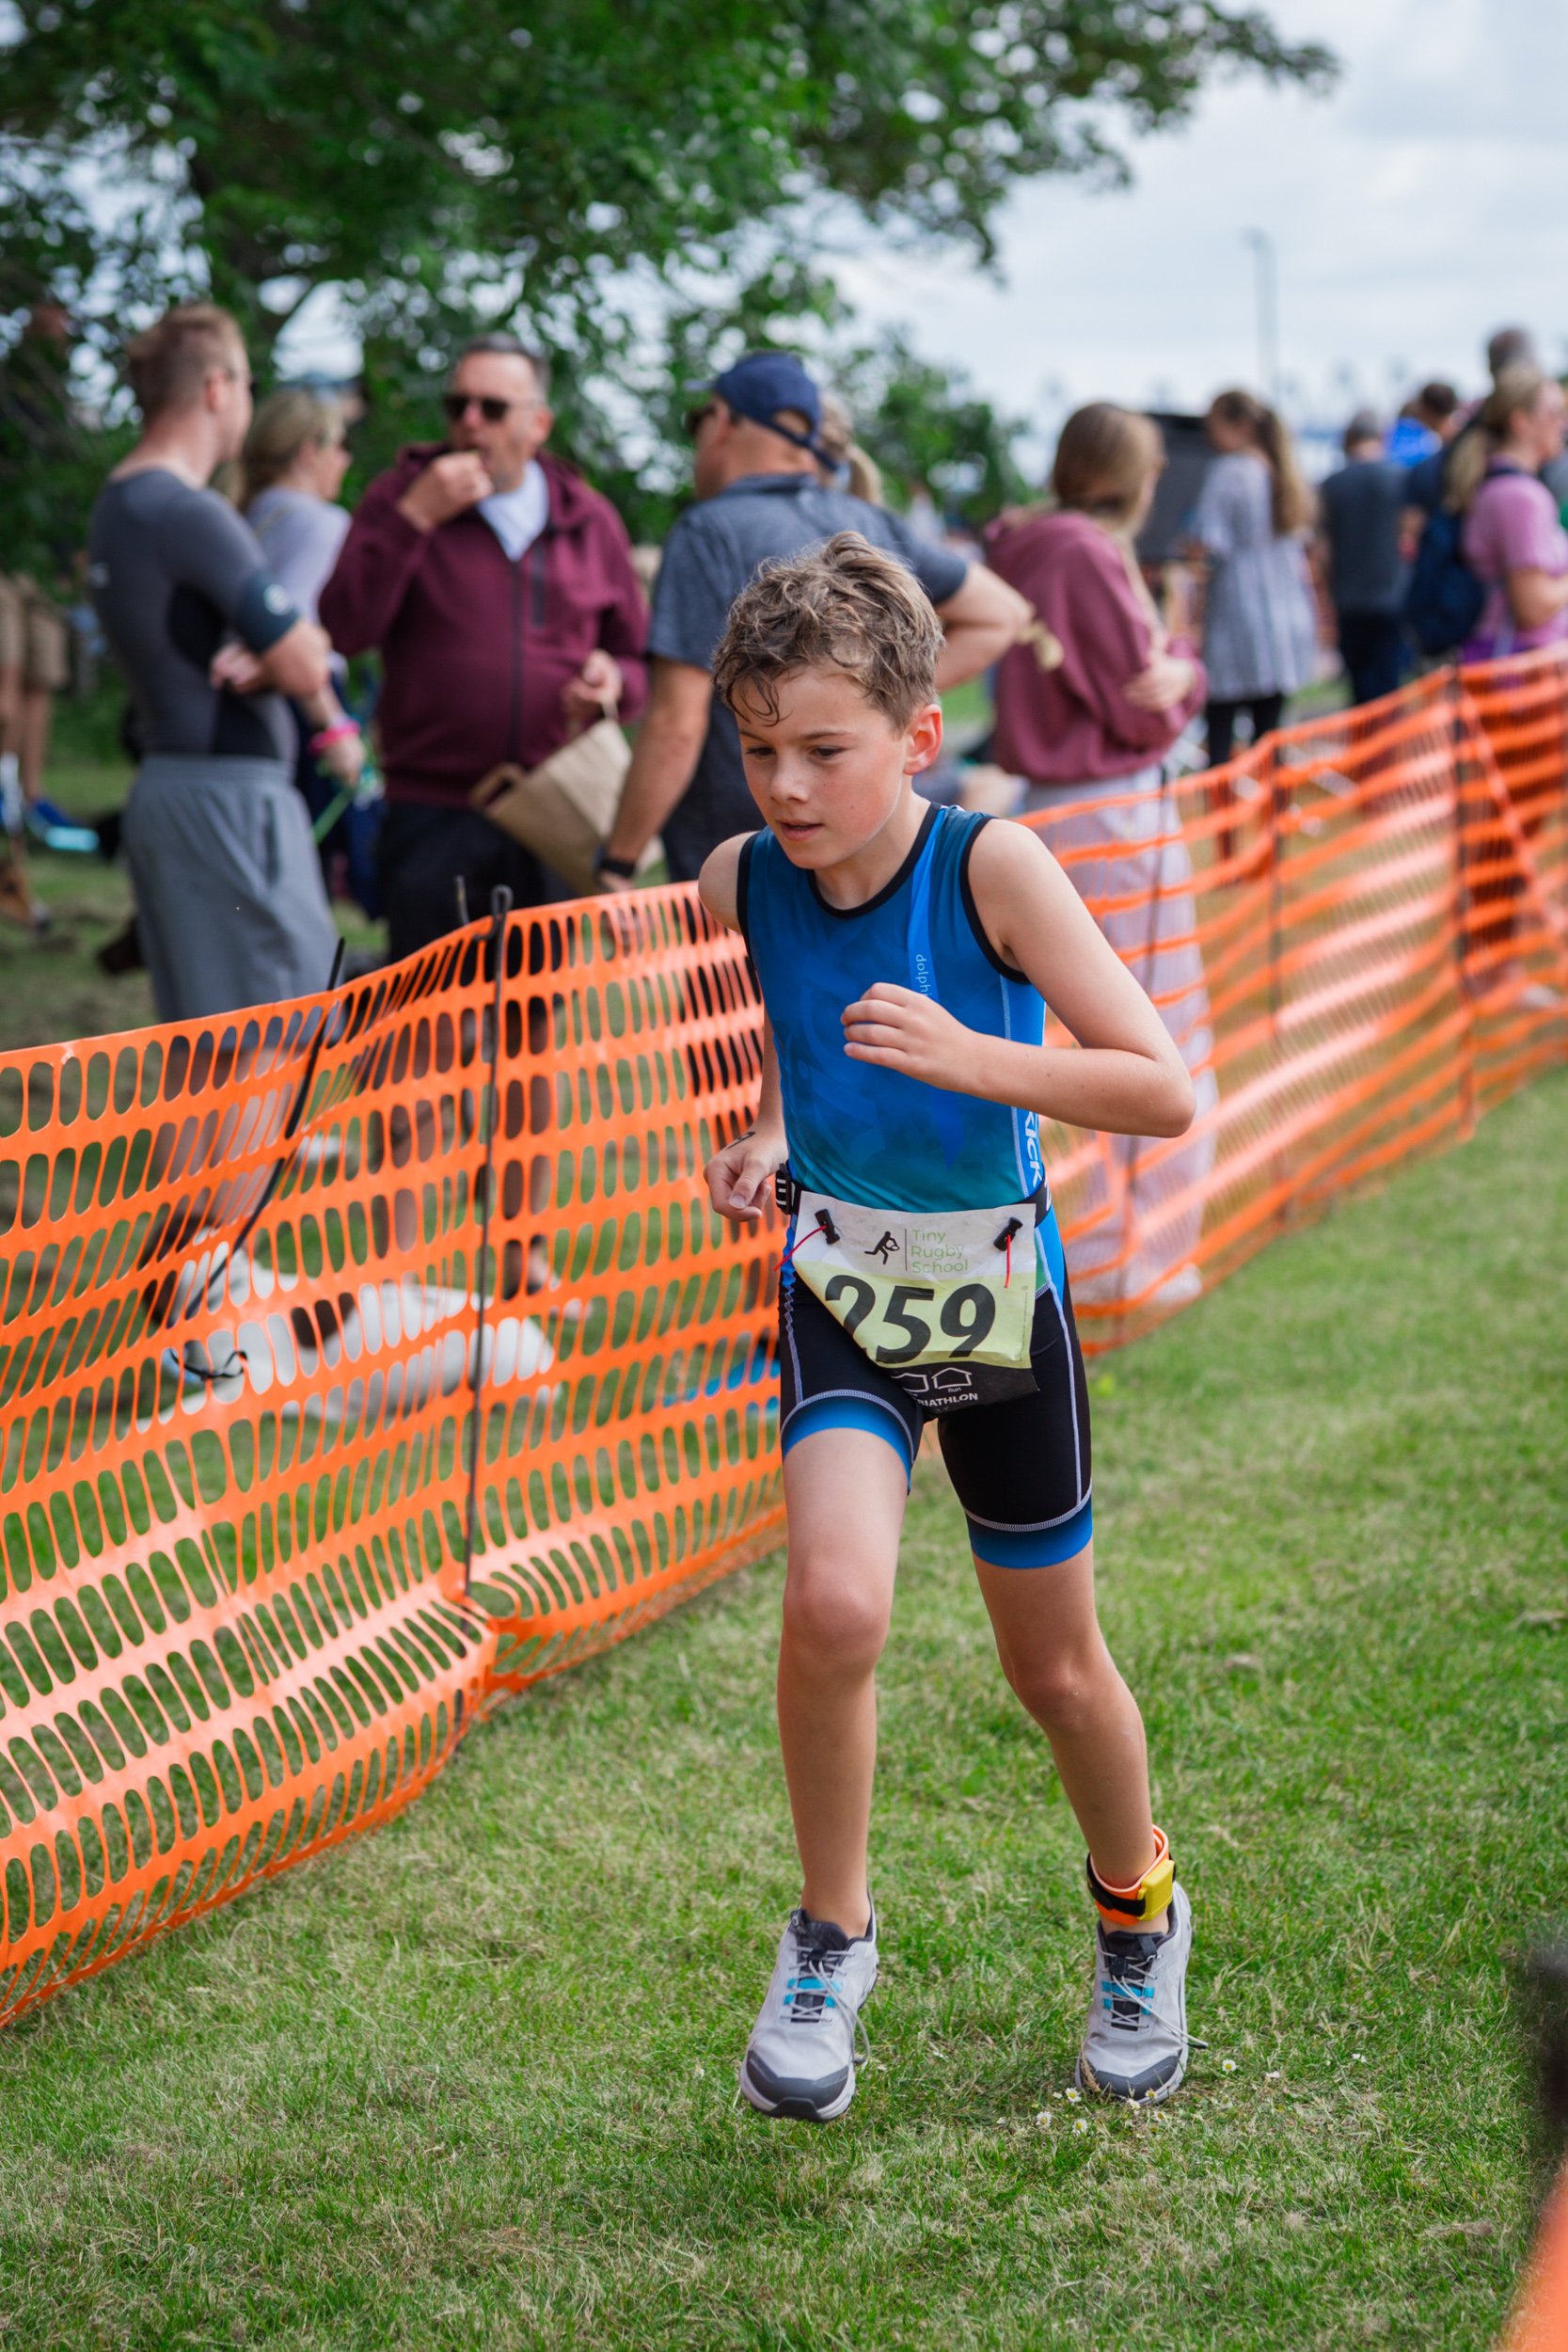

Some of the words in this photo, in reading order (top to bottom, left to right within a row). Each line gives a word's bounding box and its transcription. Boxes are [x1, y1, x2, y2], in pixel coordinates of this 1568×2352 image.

[911, 1229, 946, 1244] Tiny
[911, 1242, 964, 1261] Rugby
[911, 1258, 969, 1273] School
[825, 1275, 996, 1364] 259
[914, 1392, 978, 1407] RIATHLON
